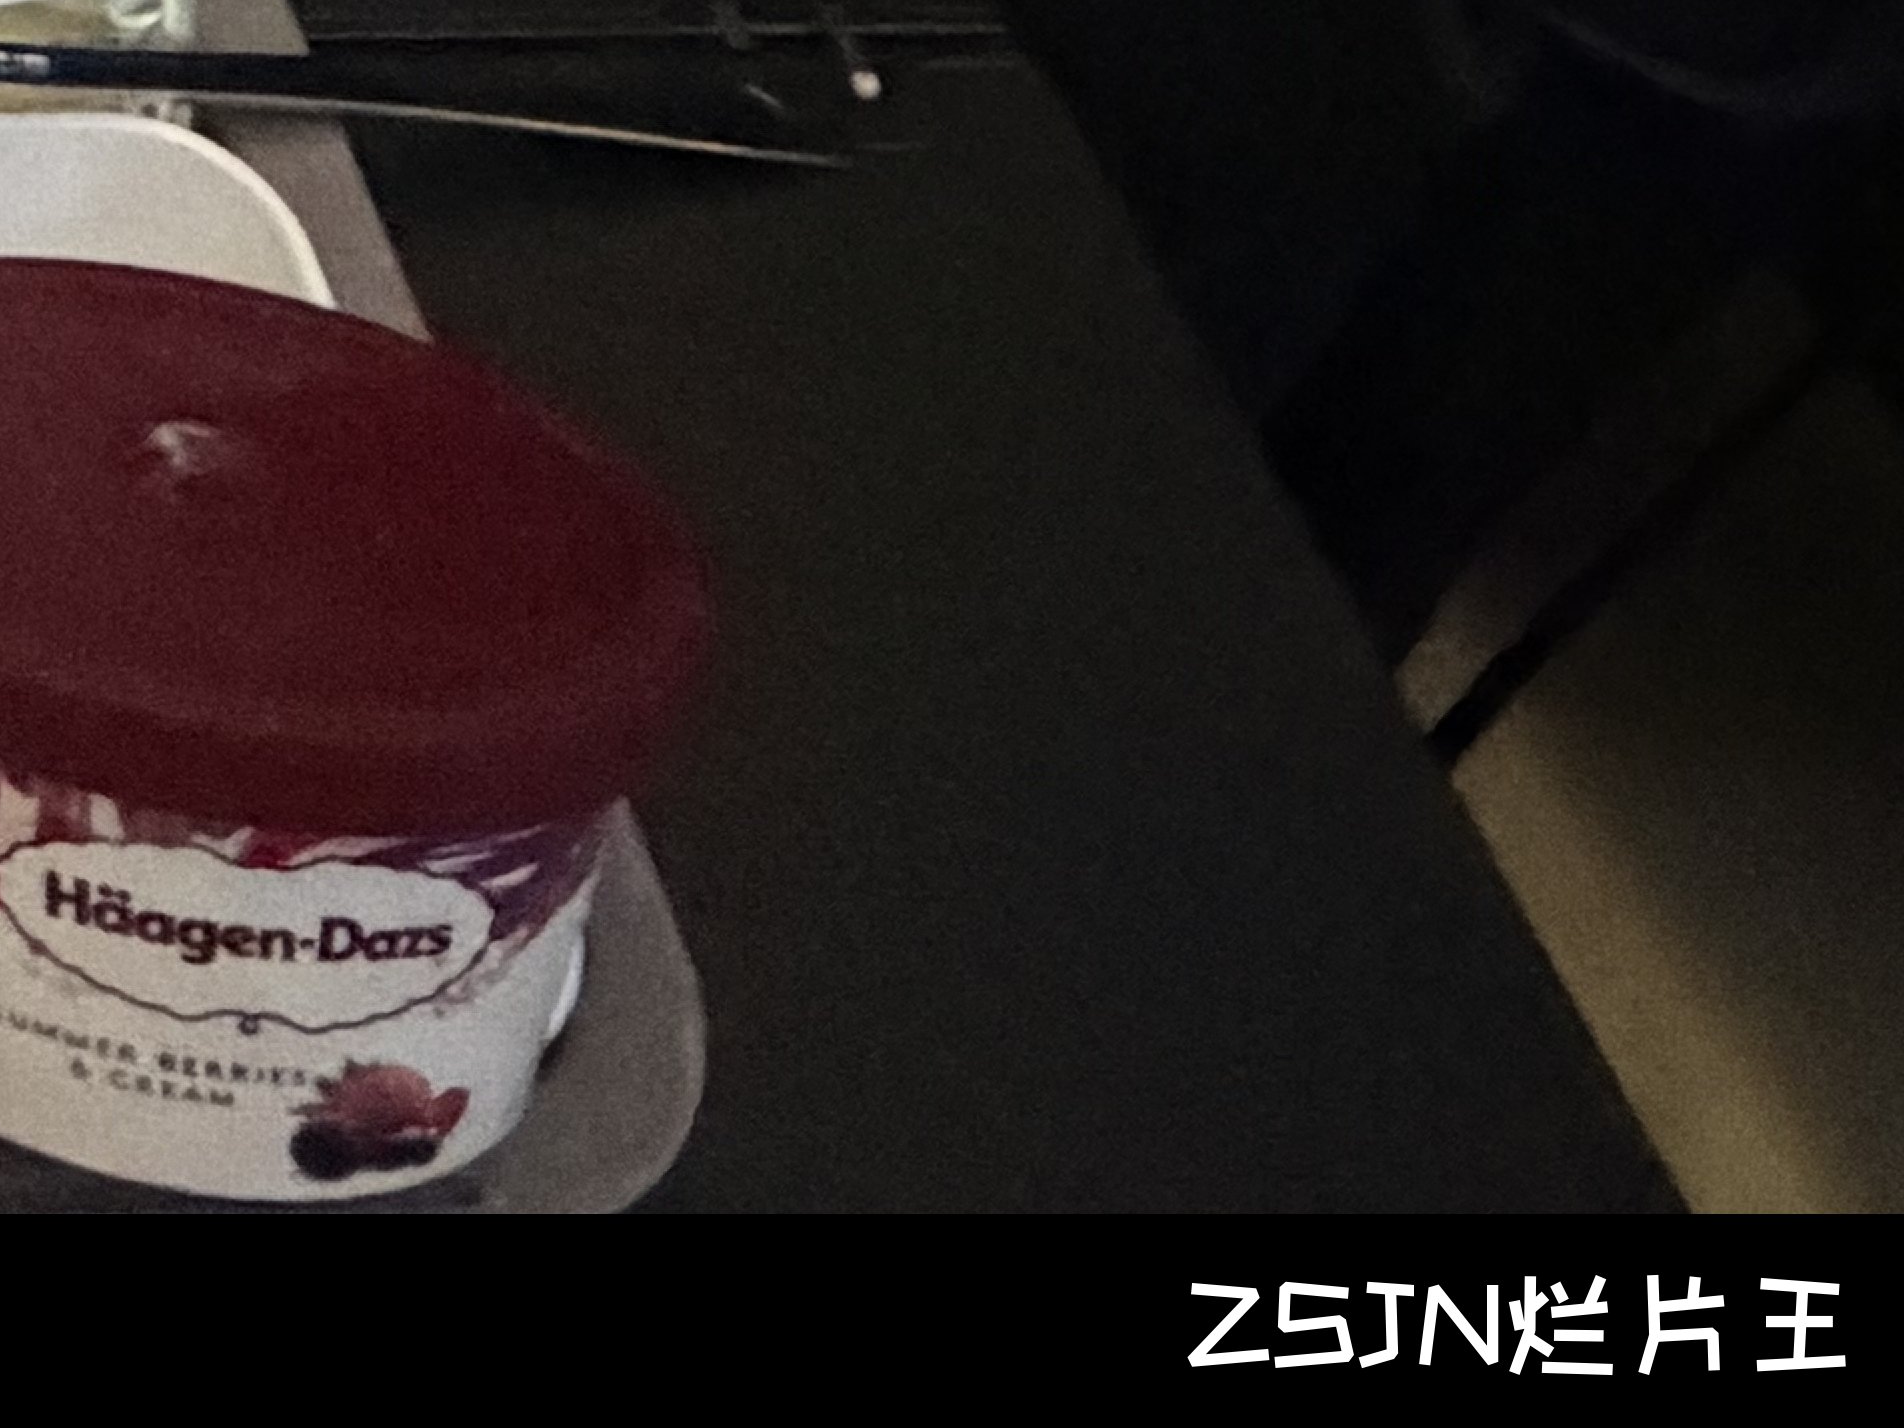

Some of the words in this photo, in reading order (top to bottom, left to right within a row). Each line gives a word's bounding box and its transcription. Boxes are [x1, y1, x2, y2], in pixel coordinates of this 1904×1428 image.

[44, 869, 454, 966] Häagen-Dazs
[107, 1066, 235, 1107] CREAM
[156, 1050, 306, 1088] BERRIES
